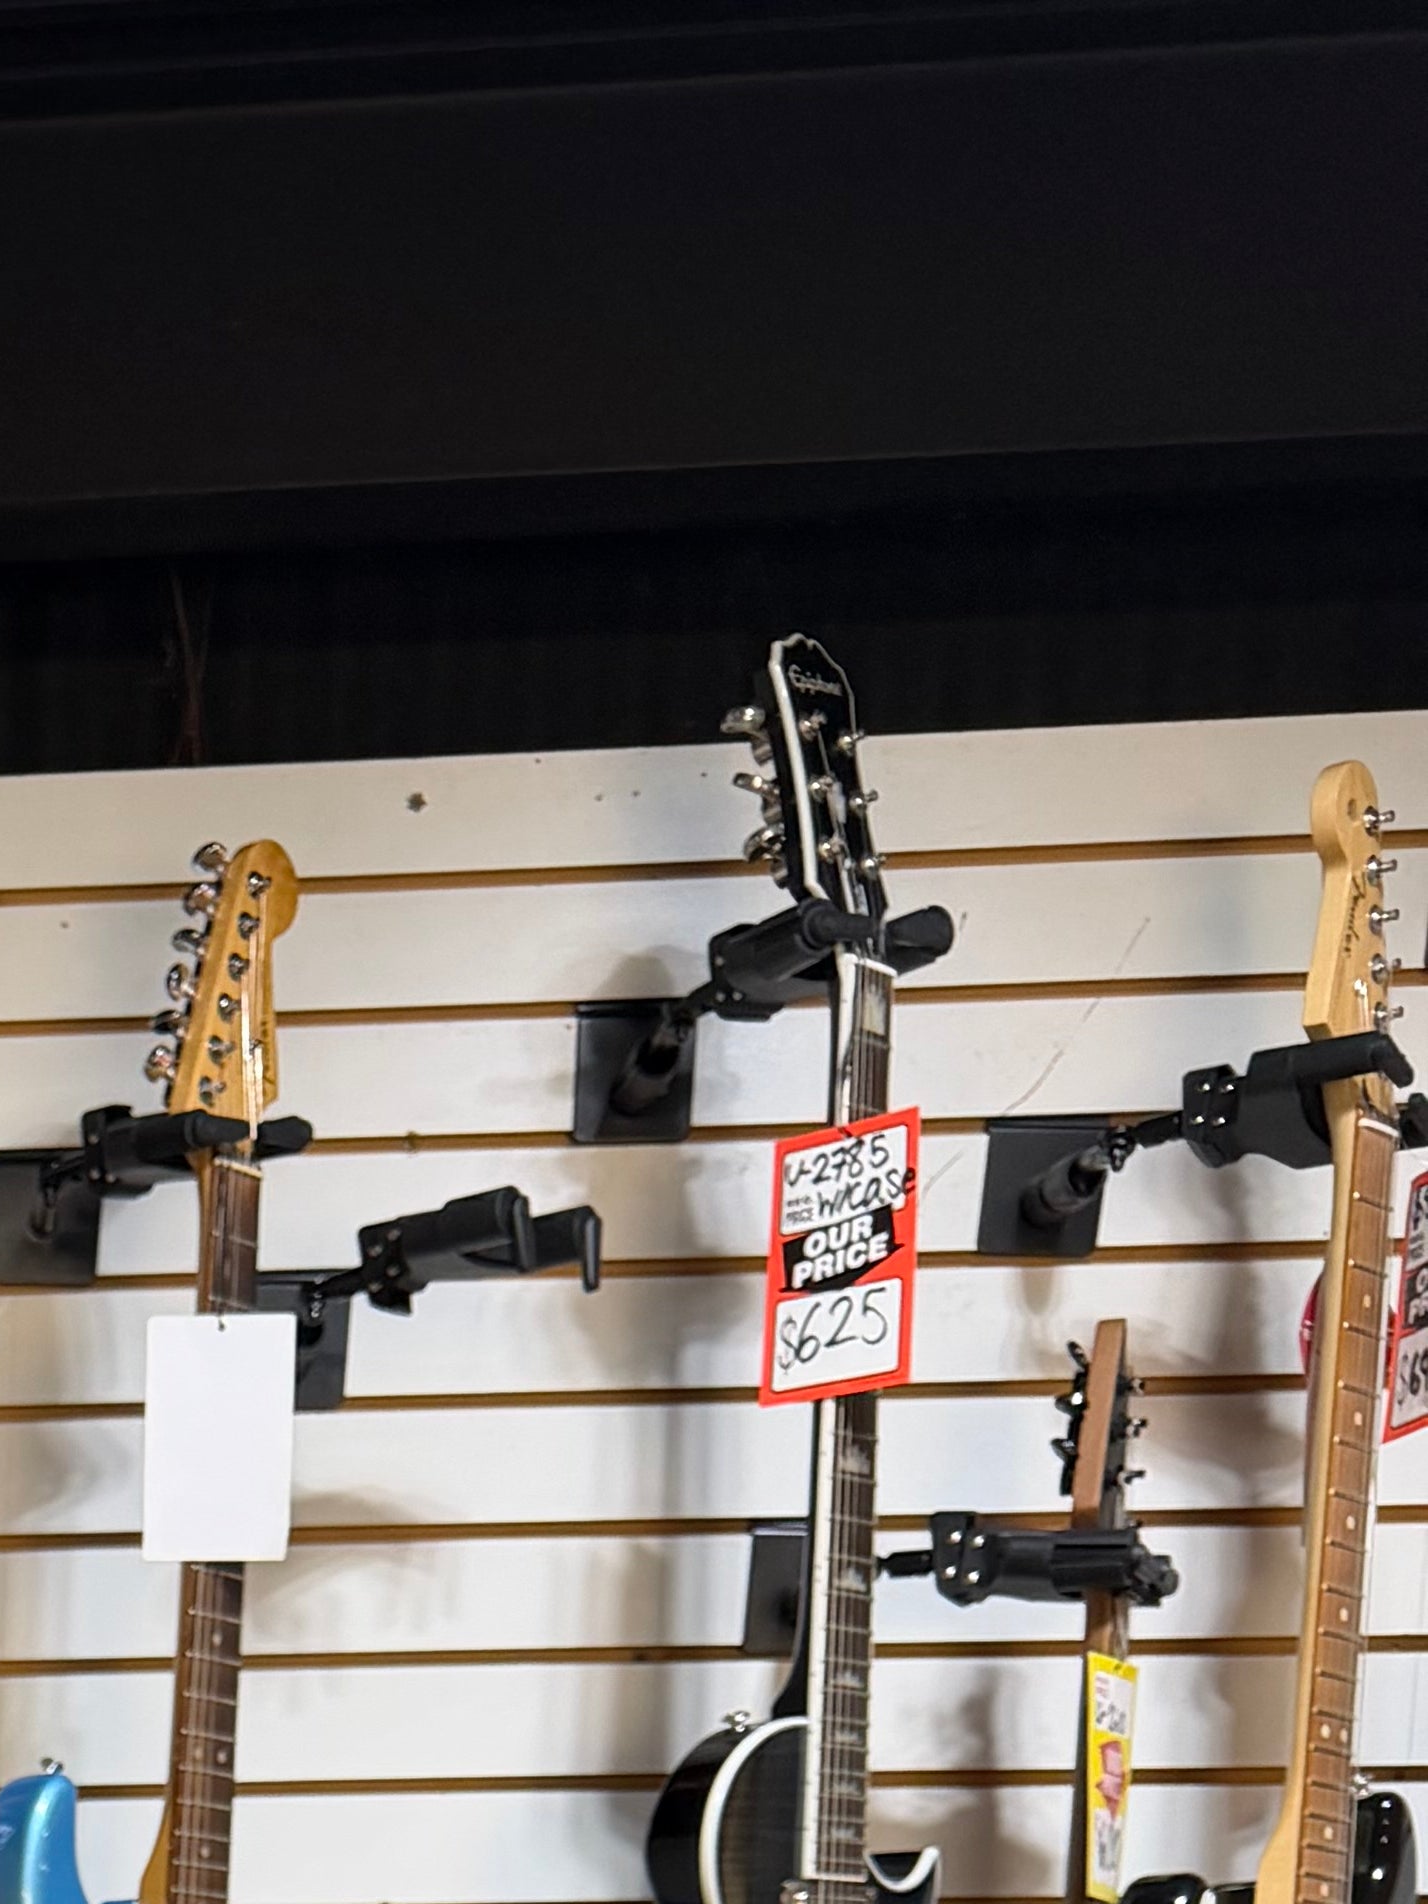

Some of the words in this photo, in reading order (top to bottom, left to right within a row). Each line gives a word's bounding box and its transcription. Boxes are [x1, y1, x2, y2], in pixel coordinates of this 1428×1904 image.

[792, 1232, 890, 1290] PRICE
[803, 1214, 873, 1258] OUR
[778, 1286, 887, 1374] $625
